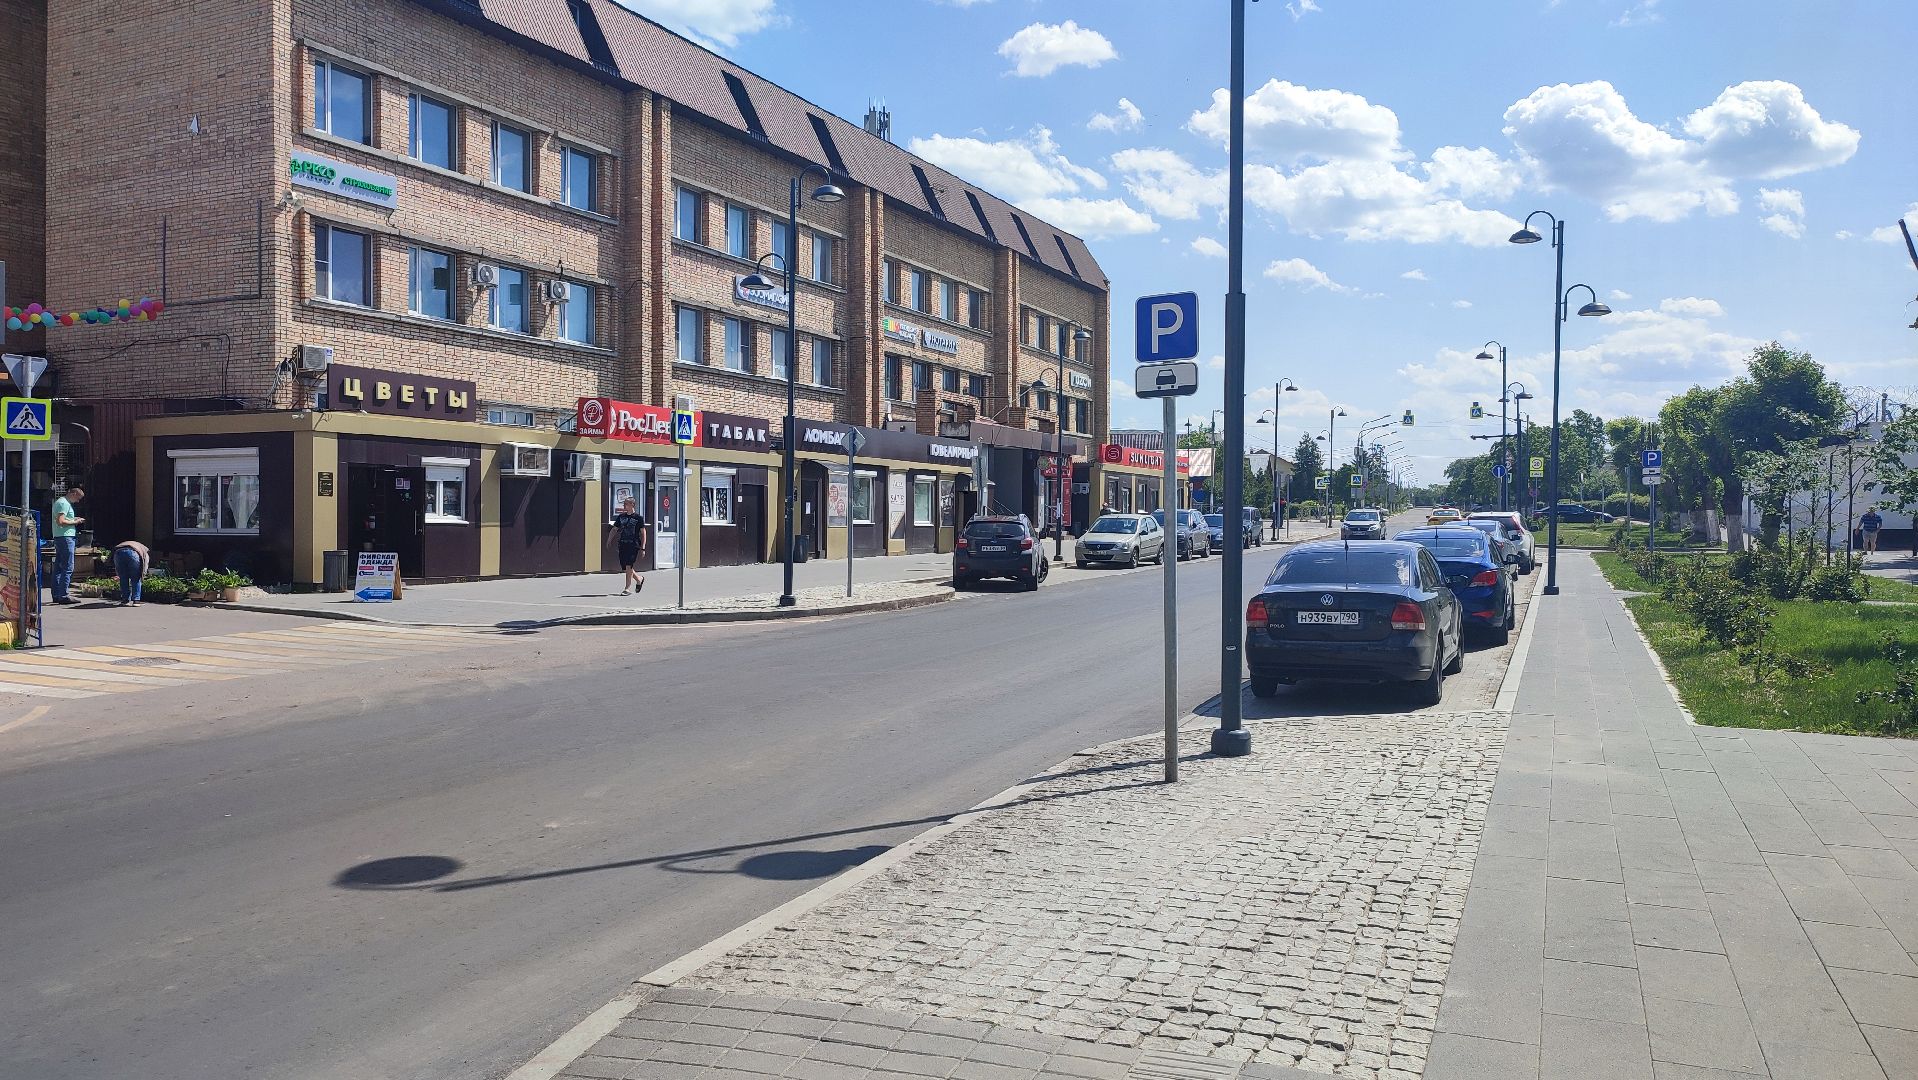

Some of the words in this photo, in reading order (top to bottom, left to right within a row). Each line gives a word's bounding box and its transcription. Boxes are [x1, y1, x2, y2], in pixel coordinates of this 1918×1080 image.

[343, 176, 392, 196] СТРАХОВАНИЕ
[1151, 303, 1183, 353] P
[344, 377, 468, 409] ЦВЕТЫ
[579, 427, 605, 435] ЗАЙМЫ
[709, 423, 766, 442] ТАБАК
[931, 444, 979, 459] ЮВЕЛИРНЫЙ
[1130, 452, 1163, 466] SUNLIGHT
[1648, 452, 1657, 465] P
[1341, 612, 1357, 621] 790
